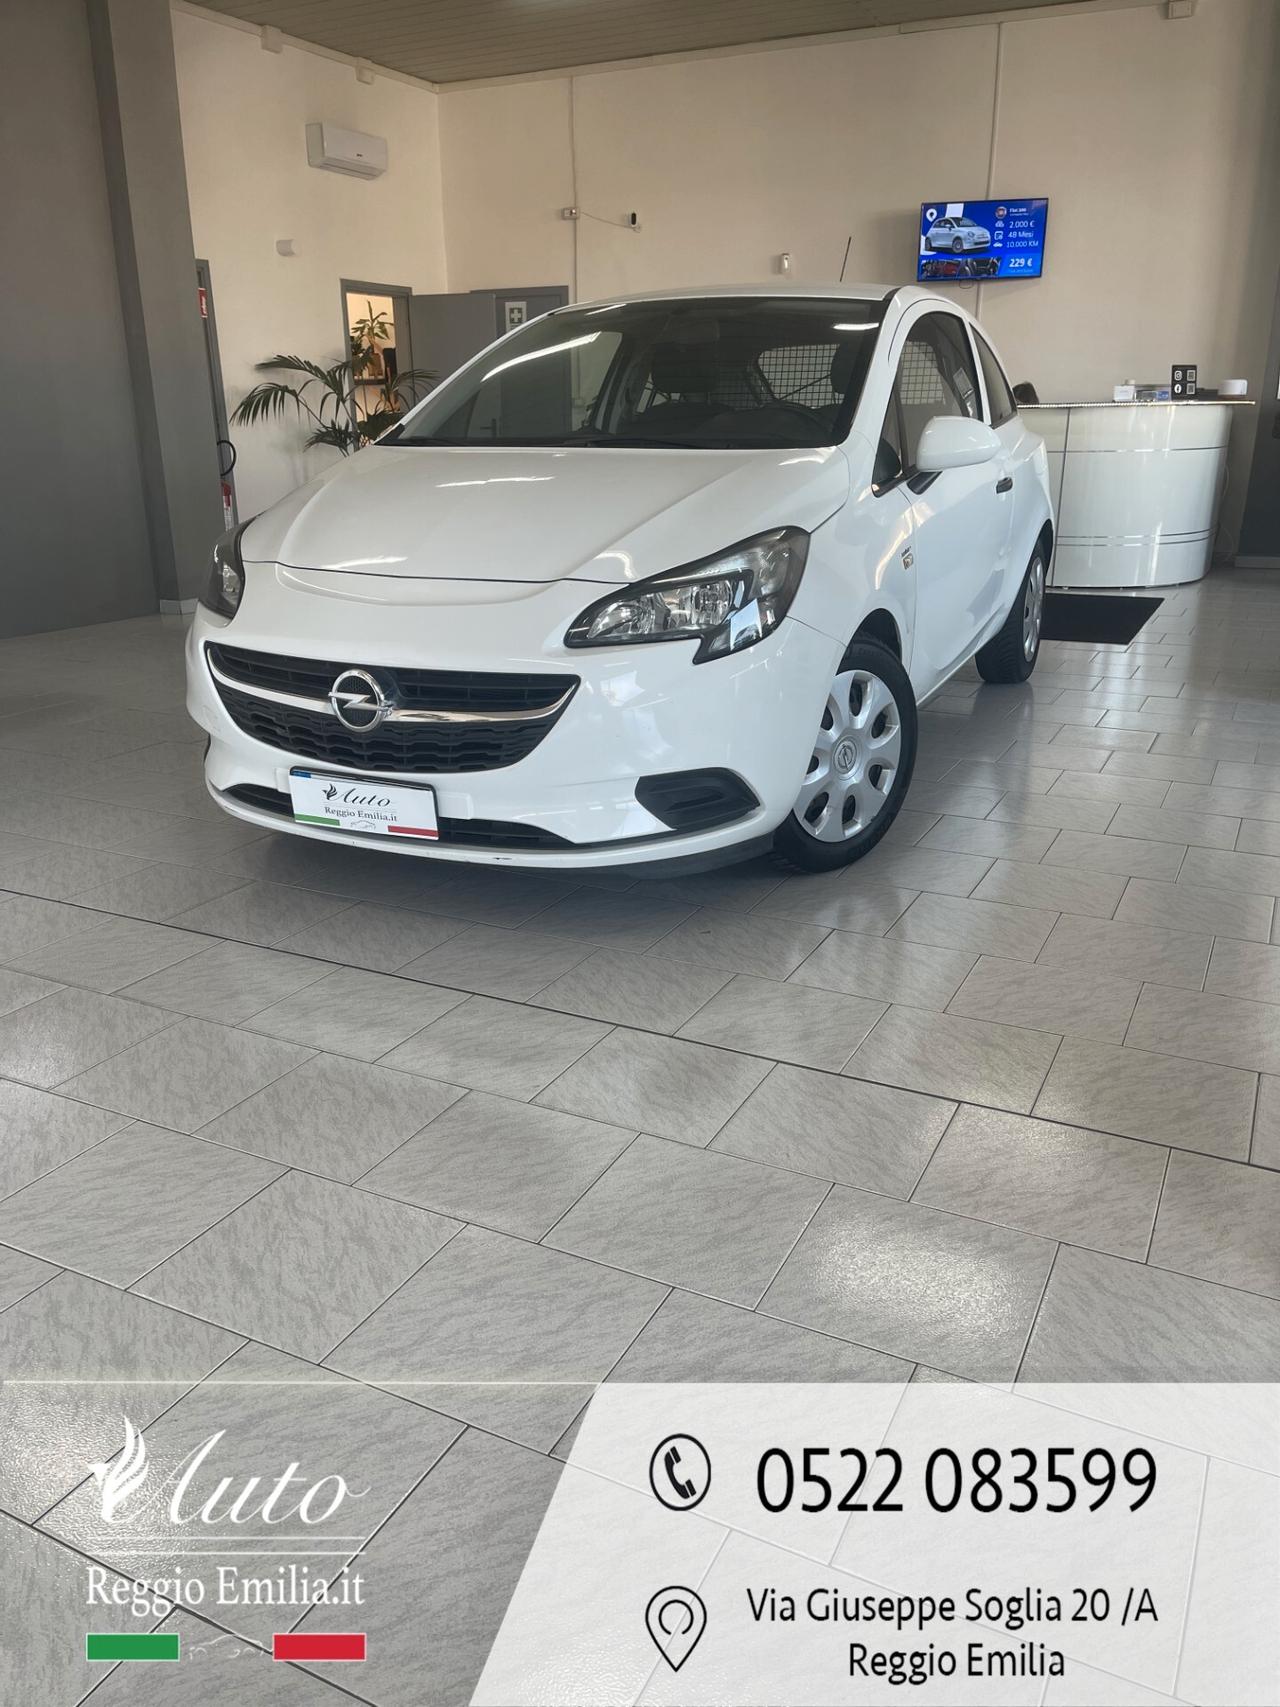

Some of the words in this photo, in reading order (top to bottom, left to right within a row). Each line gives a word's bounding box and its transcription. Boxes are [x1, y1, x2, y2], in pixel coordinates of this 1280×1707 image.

[1029, 220, 1035, 228] €
[1018, 230, 1034, 238] Mesi
[1009, 258, 1025, 268] 229
[1027, 257, 1033, 267] €
[324, 806, 355, 818] Reggio
[357, 810, 397, 822] Emilia.it
